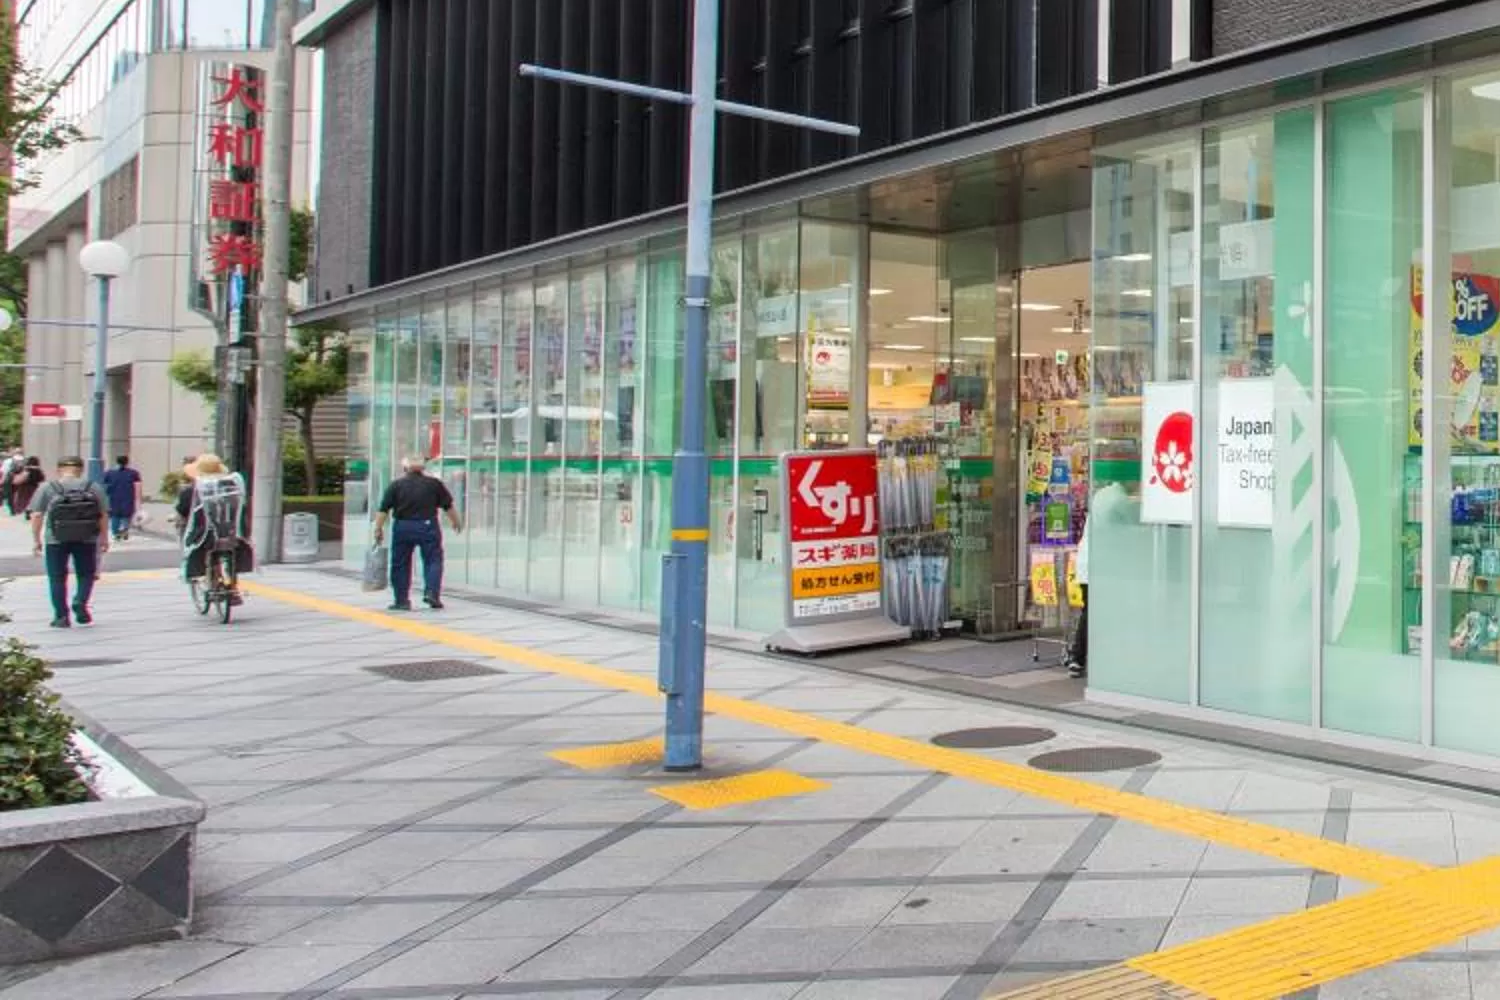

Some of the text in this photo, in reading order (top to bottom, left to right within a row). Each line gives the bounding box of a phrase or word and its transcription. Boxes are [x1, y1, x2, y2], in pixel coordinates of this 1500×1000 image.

[208, 67, 265, 276] 大和証券
[1455, 293, 1489, 321] OFF
[1226, 416, 1273, 440] Japan
[798, 460, 876, 533] くすり
[798, 542, 876, 564] スギ薬局
[801, 570, 876, 591] 処方せん受付
